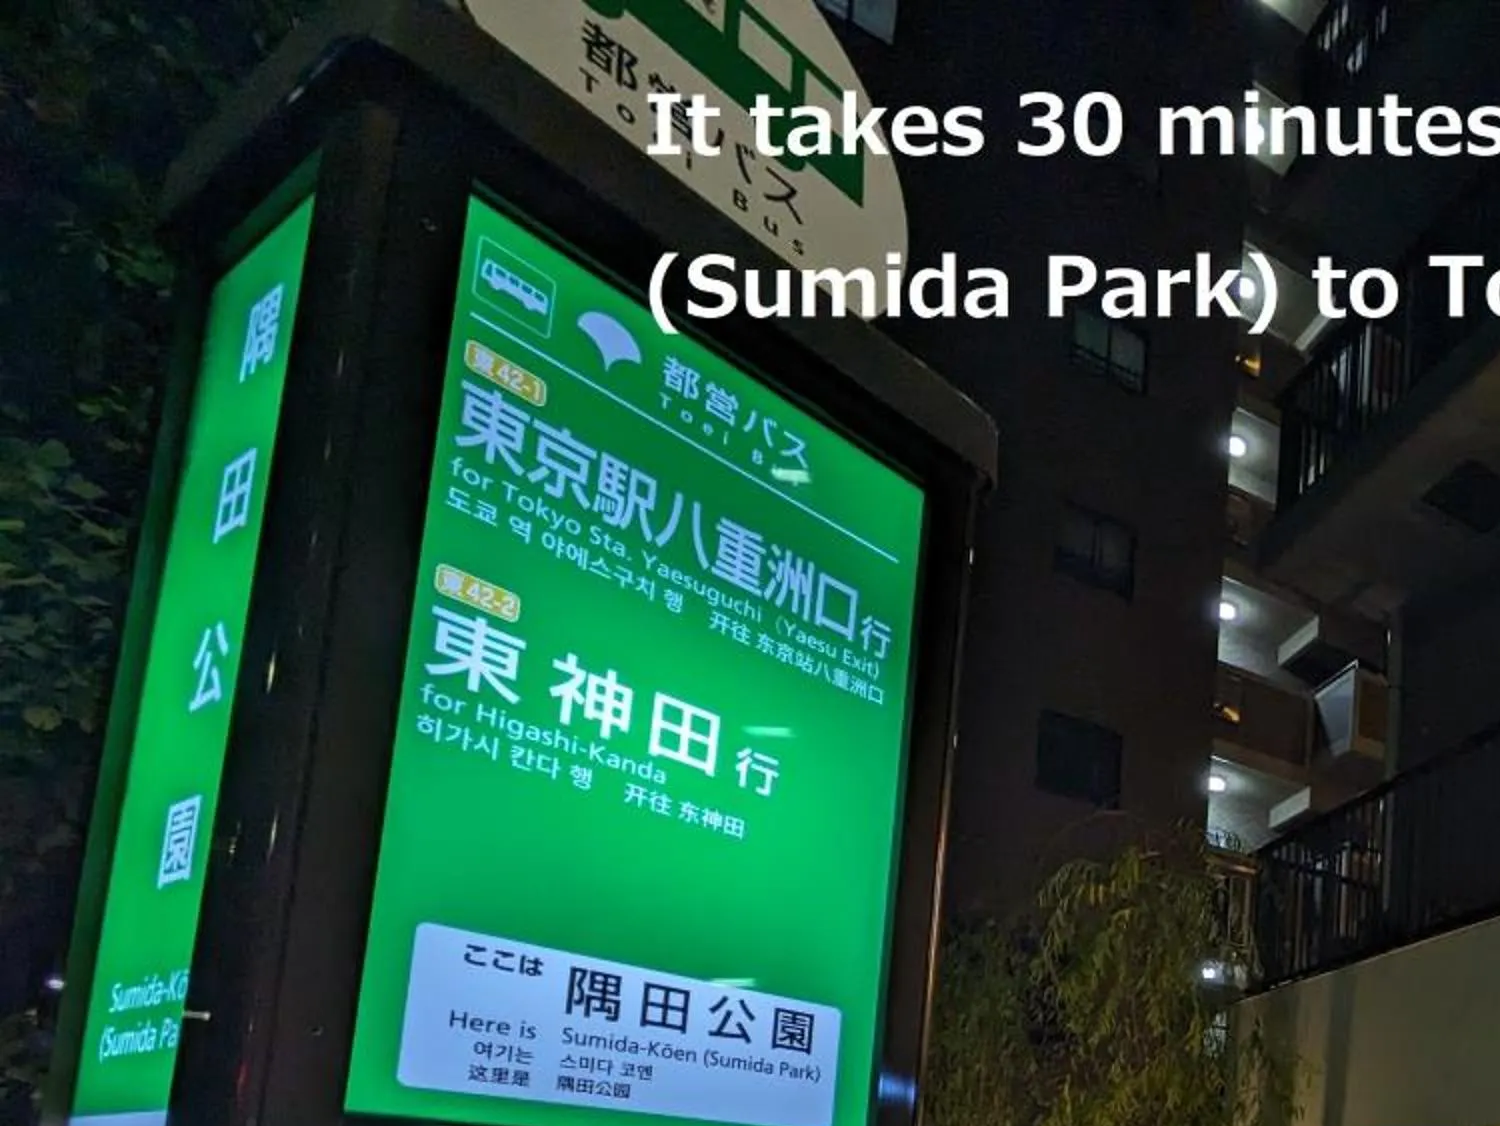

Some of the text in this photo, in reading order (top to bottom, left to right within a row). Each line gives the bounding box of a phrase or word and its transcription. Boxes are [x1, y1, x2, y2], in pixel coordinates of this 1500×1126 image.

[663, 356, 808, 468] 都営バス
[447, 487, 498, 527] 도쿄
[509, 515, 532, 544] 역
[157, 282, 284, 890] 隅田公園
[449, 456, 881, 681] for Tokyo Sta. Yaesuguchi (Yaesu Exit)
[417, 713, 593, 790] 히가시 칸다 행
[419, 683, 668, 785] for Higashi-Kanda
[99, 1020, 157, 1064] (Sumida
[464, 943, 815, 1056] ここは 隅田公園
[449, 1009, 821, 1083] Here is Sumida-Kōen (Sumida Park)
[473, 1041, 535, 1065] 여기는
[560, 1053, 614, 1075] 스미다
